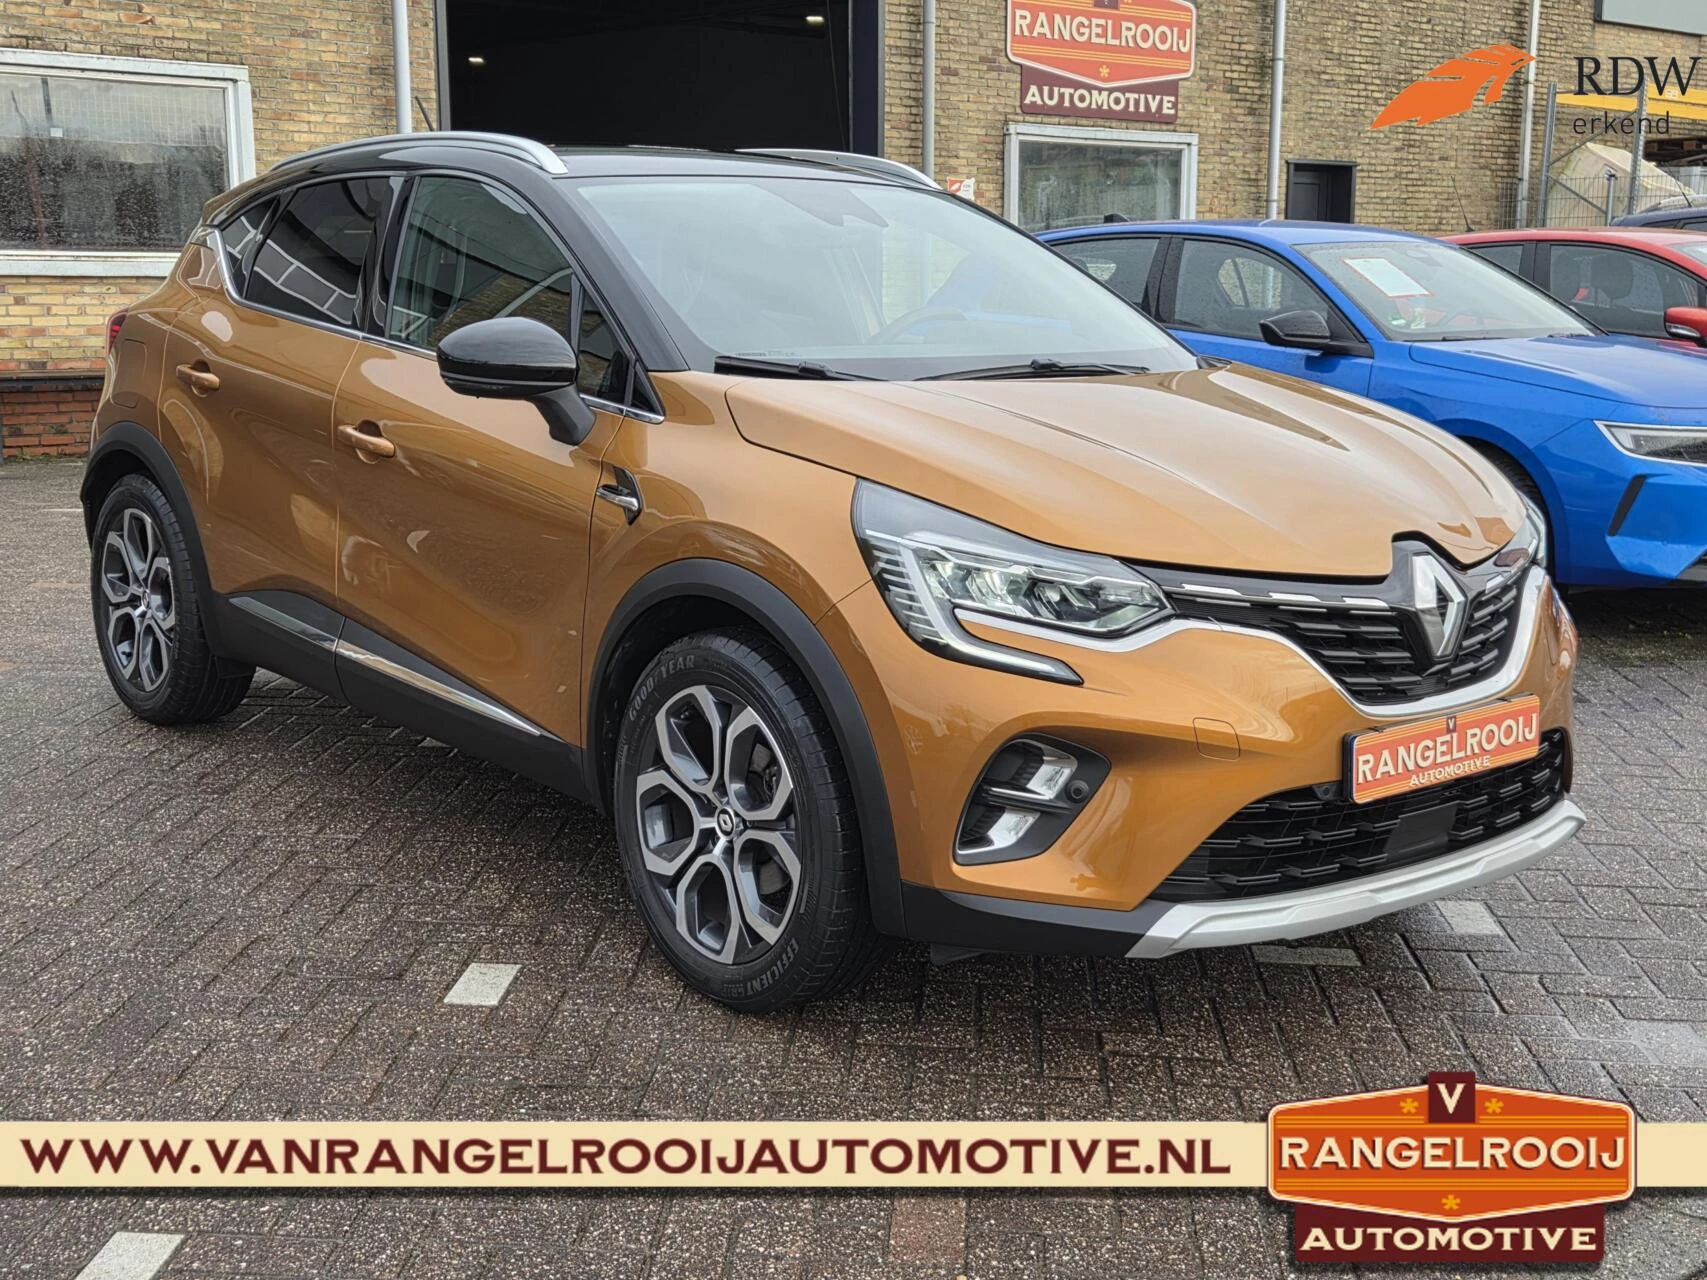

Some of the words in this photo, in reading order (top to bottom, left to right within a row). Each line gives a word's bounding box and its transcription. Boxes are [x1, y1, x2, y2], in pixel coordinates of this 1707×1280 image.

[1014, 9, 1191, 53] RANGELROOIJ
[1024, 85, 1176, 115] AUTOMOTIVE
[1447, 717, 1455, 728] V
[1357, 713, 1537, 784] RANGELROOIJ
[1409, 755, 1490, 787] AUTOMOTIVE
[746, 937, 799, 995] EFFICIENT
